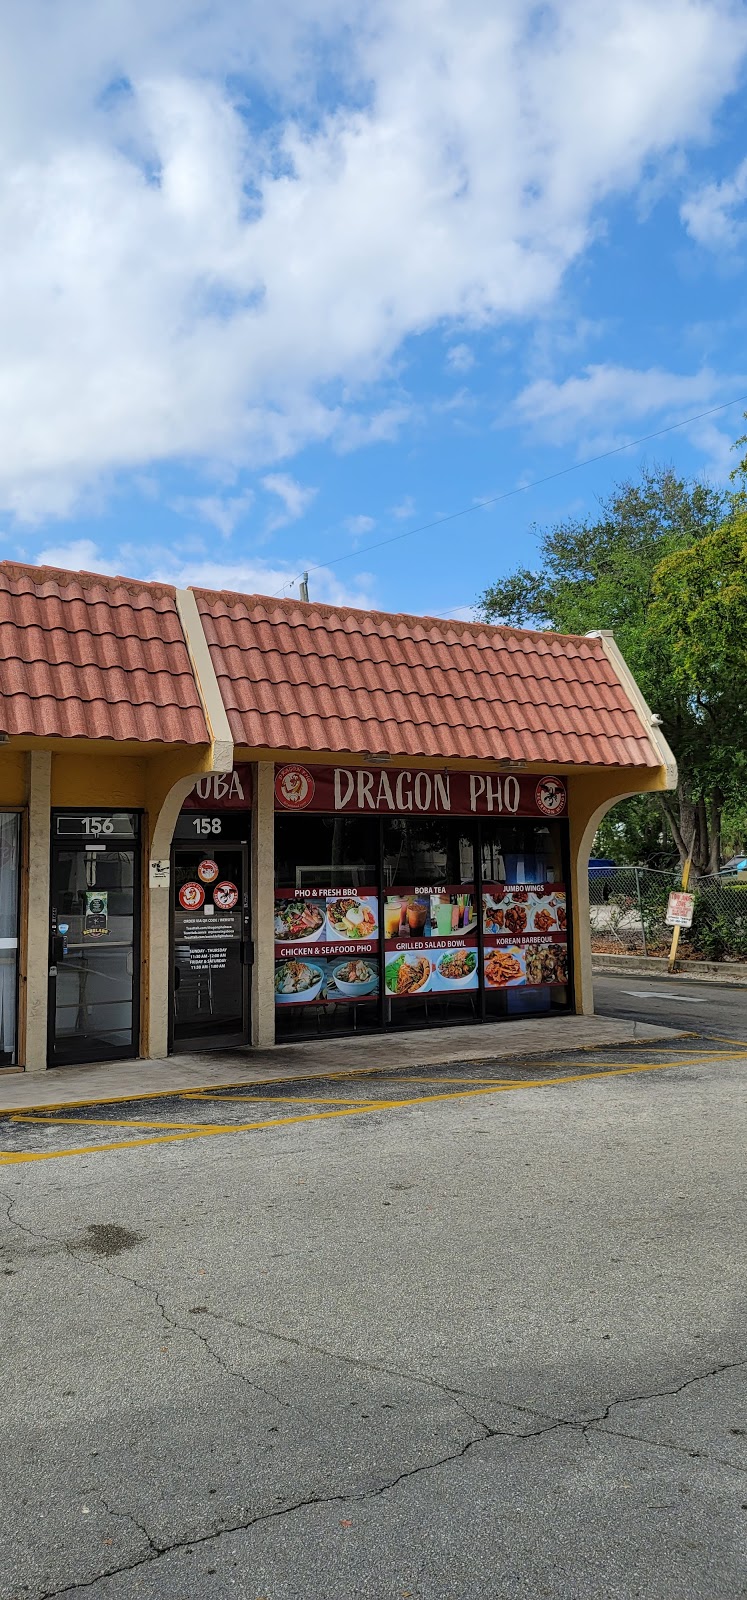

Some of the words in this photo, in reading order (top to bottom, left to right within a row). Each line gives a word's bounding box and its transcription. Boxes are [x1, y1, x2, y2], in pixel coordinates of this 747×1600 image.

[196, 771, 245, 800] OBA
[334, 768, 451, 811] DRAGON
[469, 774, 520, 813] PHO
[81, 817, 114, 834] 156
[192, 817, 222, 834] 158
[294, 889, 312, 897] PHO
[312, 889, 318, 897] &
[318, 889, 342, 897] FRESH
[342, 888, 358, 897] BBQ
[434, 886, 446, 894] TEA
[503, 885, 523, 893] JUMBO
[524, 884, 545, 892] WINGS
[424, 941, 446, 949] SALAD
[447, 940, 466, 948] BOWL
[521, 936, 552, 944] BARBEQUE
[280, 948, 314, 956] CHICKEN
[321, 945, 355, 954] SEAFOOD
[356, 944, 372, 952] PHO
